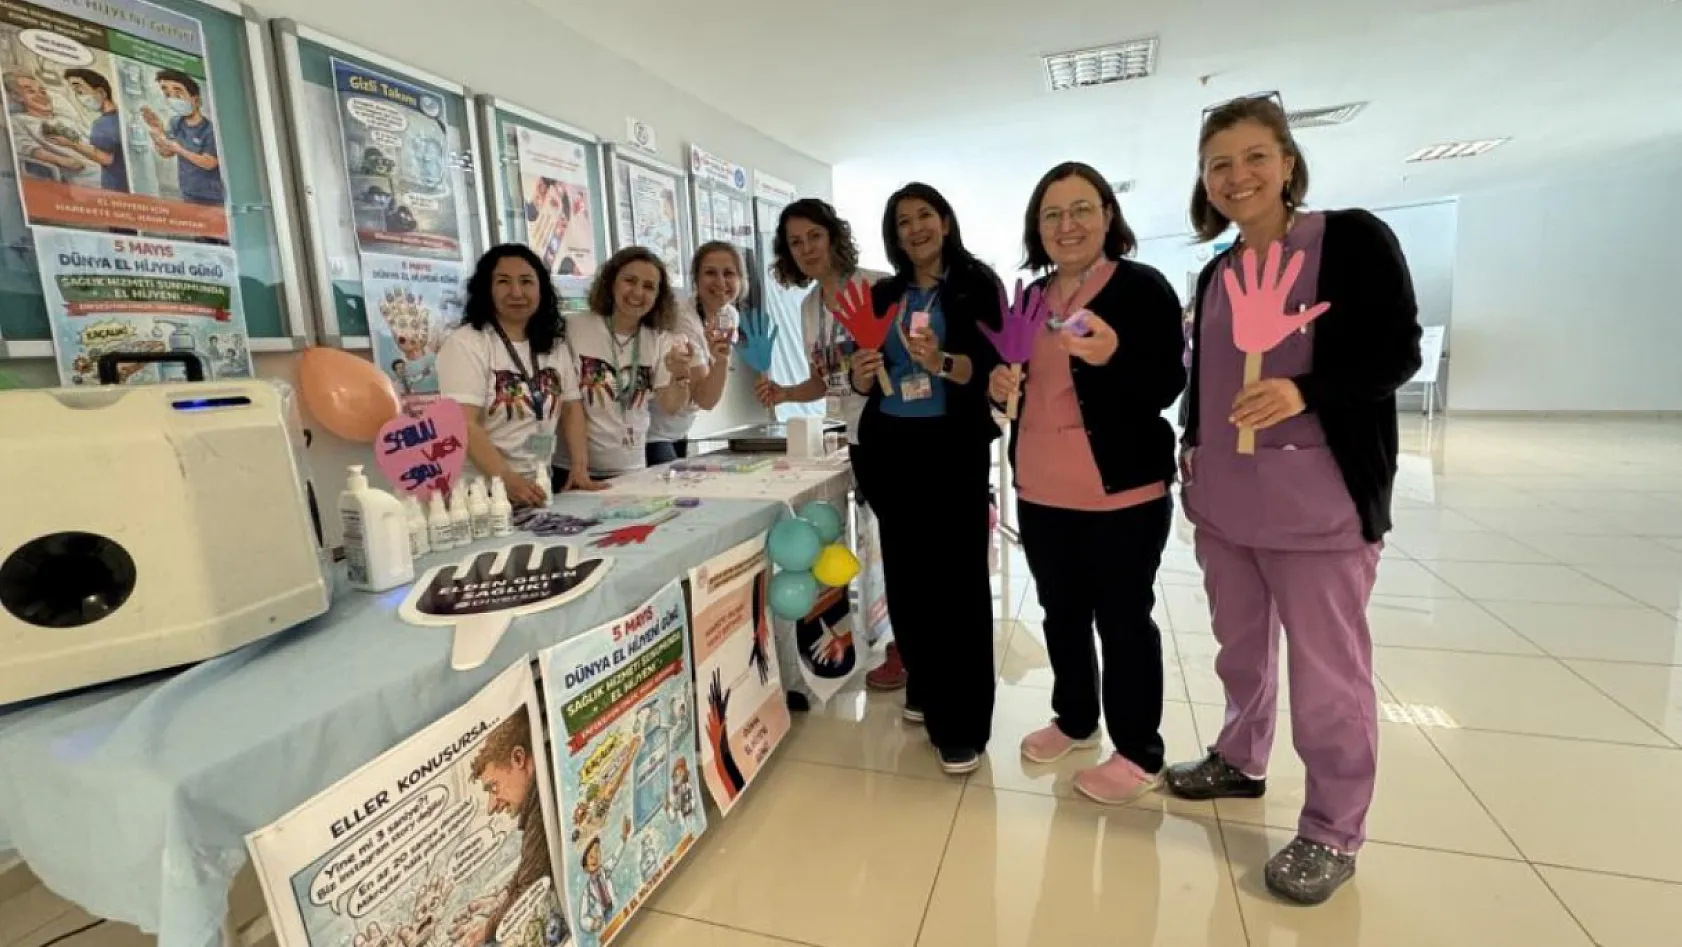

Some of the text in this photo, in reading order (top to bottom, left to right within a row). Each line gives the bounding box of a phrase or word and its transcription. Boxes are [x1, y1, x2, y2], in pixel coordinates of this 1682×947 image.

[59, 252, 112, 269] DÜNYA
[114, 258, 133, 271] EL
[188, 262, 224, 279] GÜNÜ
[114, 240, 174, 258] 5 MAYIS
[438, 570, 577, 596] ELDEN GELEN
[611, 605, 653, 641] 5 MAYIS
[564, 655, 611, 690] DÜNYA
[612, 649, 627, 665] EL
[566, 686, 606, 717] SAĞLIK
[330, 789, 391, 840] ELLER
[324, 852, 355, 879] Yine
[358, 837, 374, 855] mi
[376, 828, 385, 842] 3
[358, 880, 375, 896] En
[376, 866, 390, 882] az
[393, 851, 409, 869] 20
